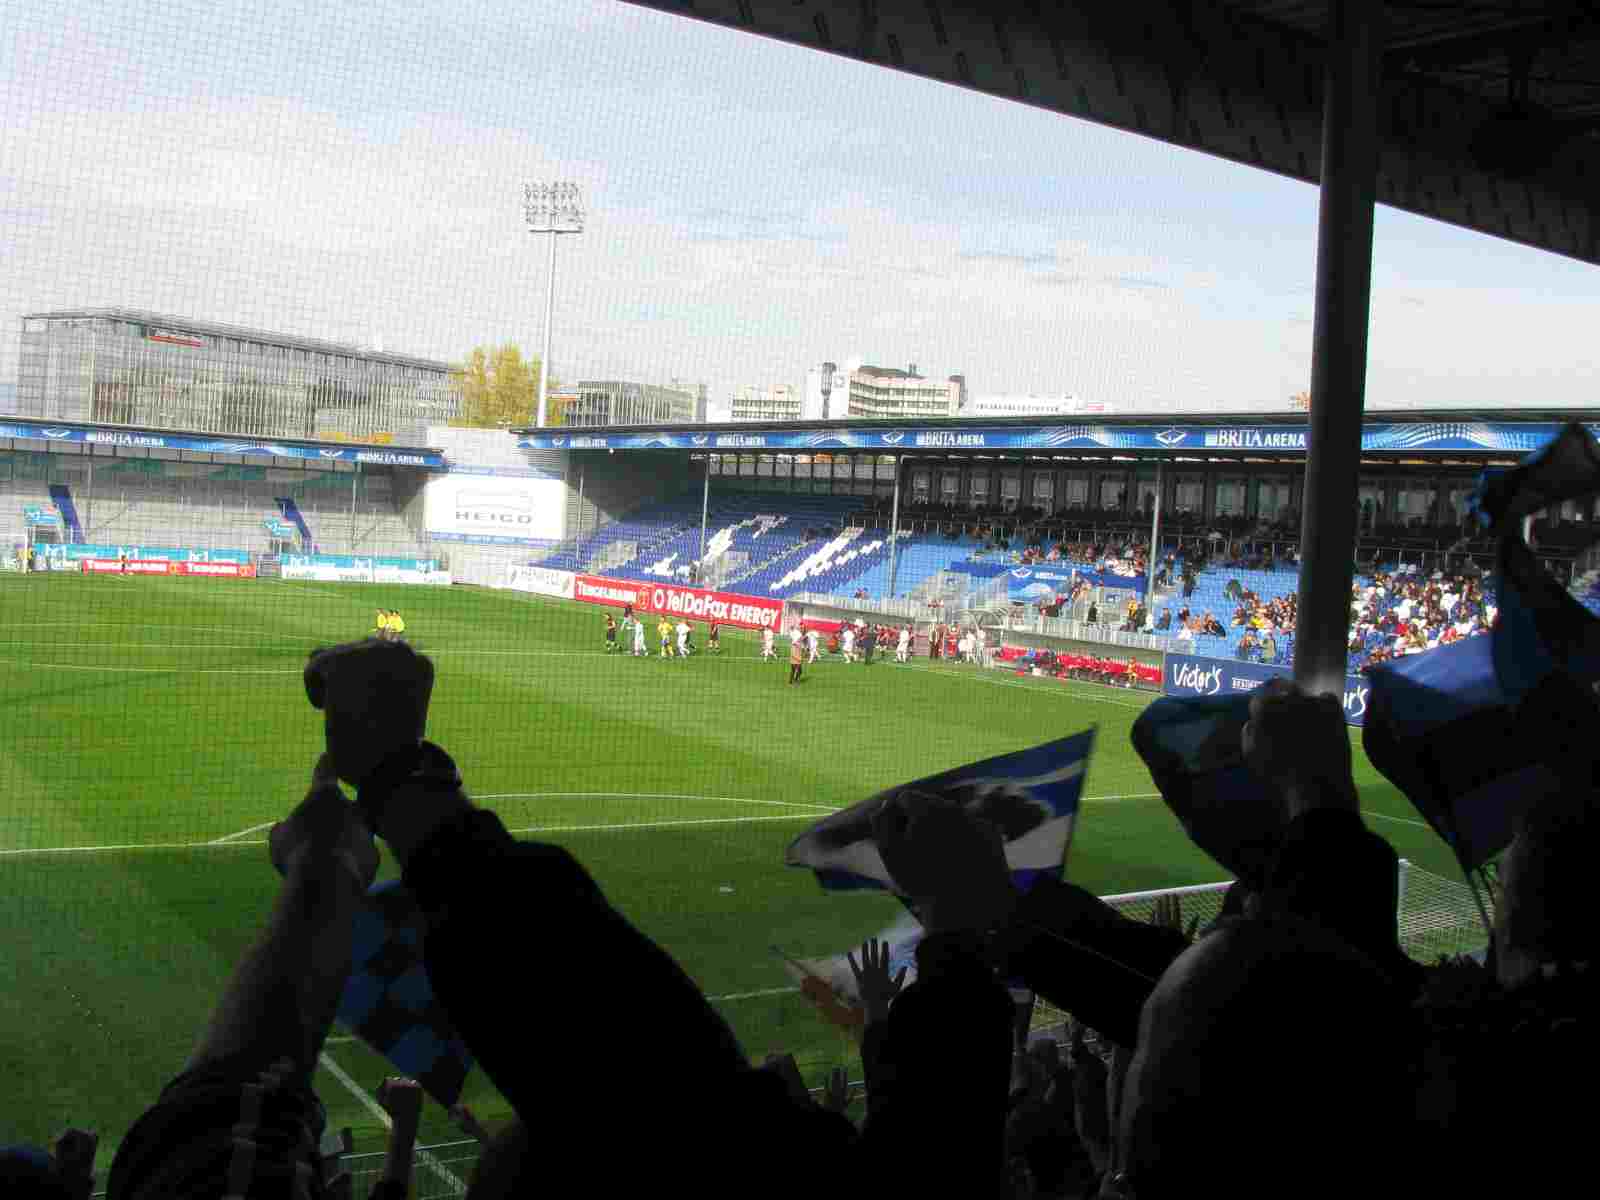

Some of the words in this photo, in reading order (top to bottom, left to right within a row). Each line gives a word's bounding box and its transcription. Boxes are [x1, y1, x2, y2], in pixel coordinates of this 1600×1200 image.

[926, 431, 957, 446] BRITA
[1216, 429, 1263, 447] BRITA
[1264, 433, 1306, 447] ARENA
[456, 511, 532, 524] HEICO
[730, 603, 780, 626] ENERGY
[1173, 662, 1223, 695] Victor's
